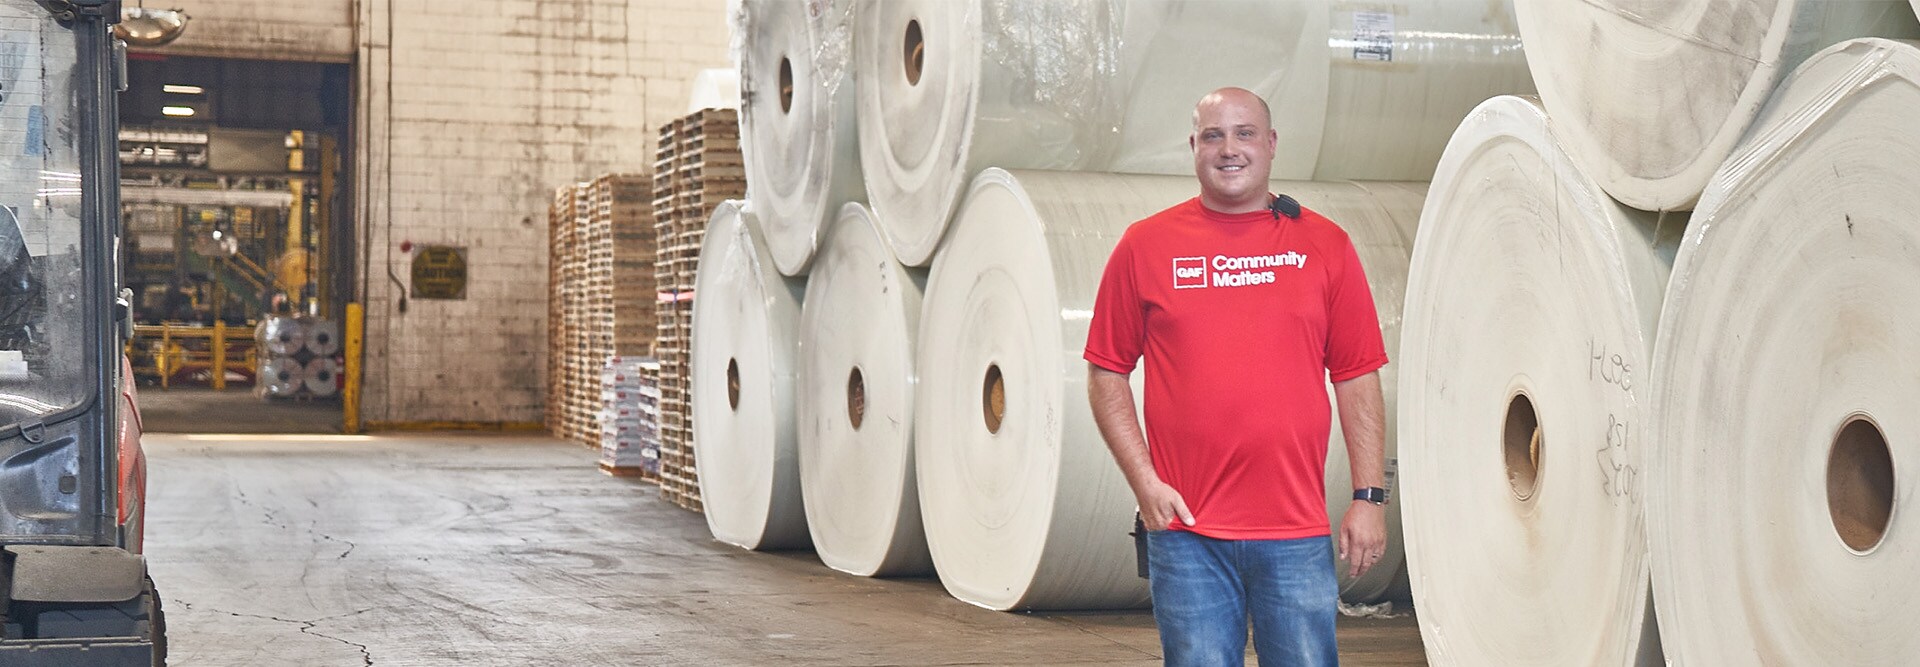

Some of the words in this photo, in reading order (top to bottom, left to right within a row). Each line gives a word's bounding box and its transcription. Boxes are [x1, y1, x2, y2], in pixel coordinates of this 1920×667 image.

[1211, 250, 1307, 271] Community
[1176, 267, 1204, 279] GAF
[1212, 270, 1276, 288] Matters
